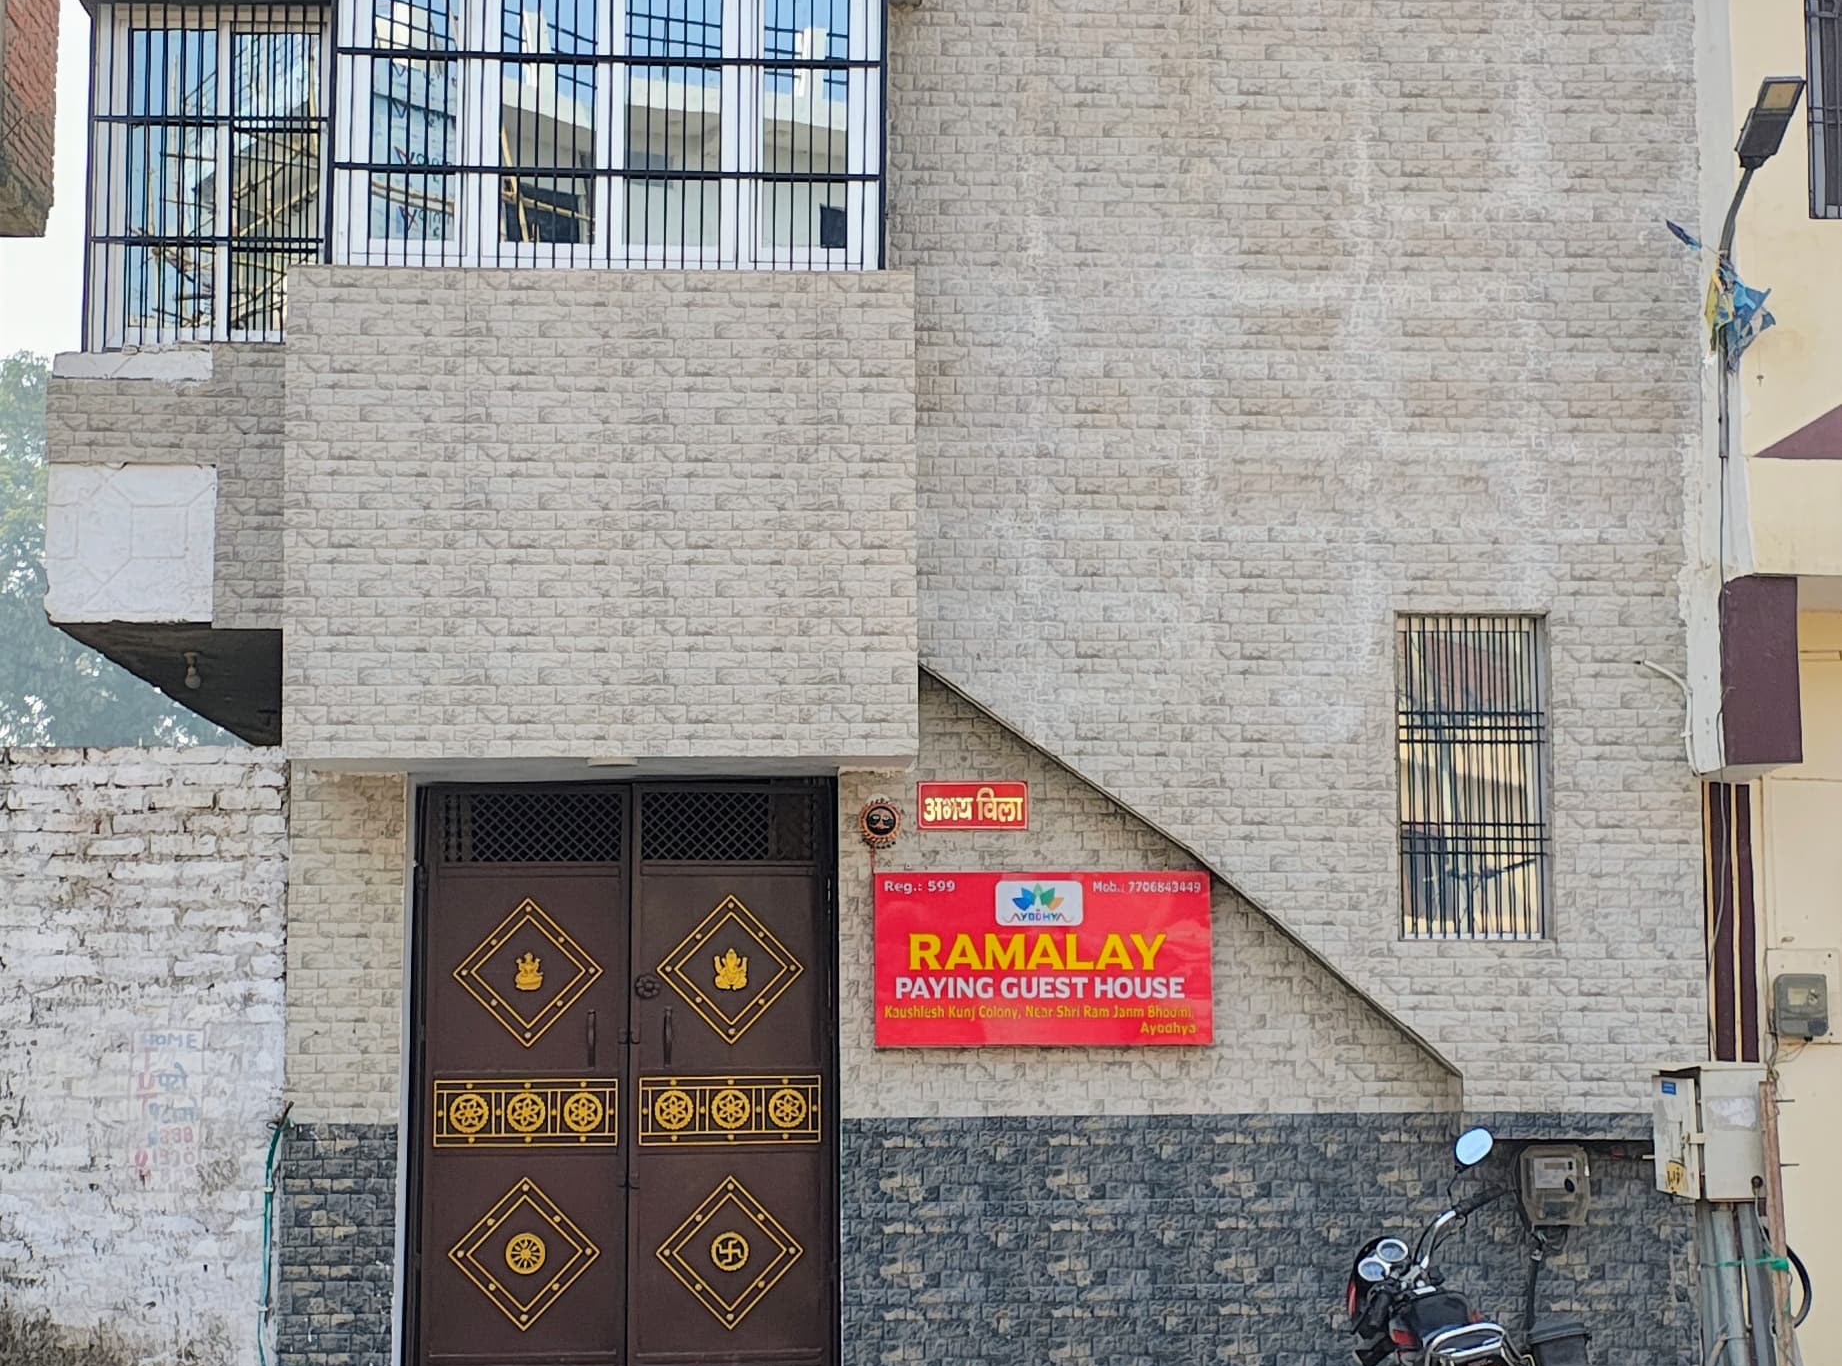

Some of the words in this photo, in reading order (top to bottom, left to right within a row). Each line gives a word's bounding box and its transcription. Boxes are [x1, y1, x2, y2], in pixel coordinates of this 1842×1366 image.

[923, 797, 974, 822] अभय
[976, 787, 1023, 822] विला
[884, 880, 923, 895] Reg.:
[927, 880, 956, 892] 599
[908, 933, 1167, 971] RAMALAY
[895, 977, 994, 999] PAYING
[1000, 977, 1088, 999] GUEST
[1094, 977, 1186, 999] HOUSE
[948, 1005, 976, 1022] Kunj
[978, 1005, 1022, 1020] Colony,
[1025, 1005, 1053, 1019] Near
[1056, 1005, 1080, 1019] Shri
[1083, 1005, 1110, 1019] Ram
[1112, 1005, 1145, 1019] Janm
[1139, 1021, 1197, 1036] Ayodhya
